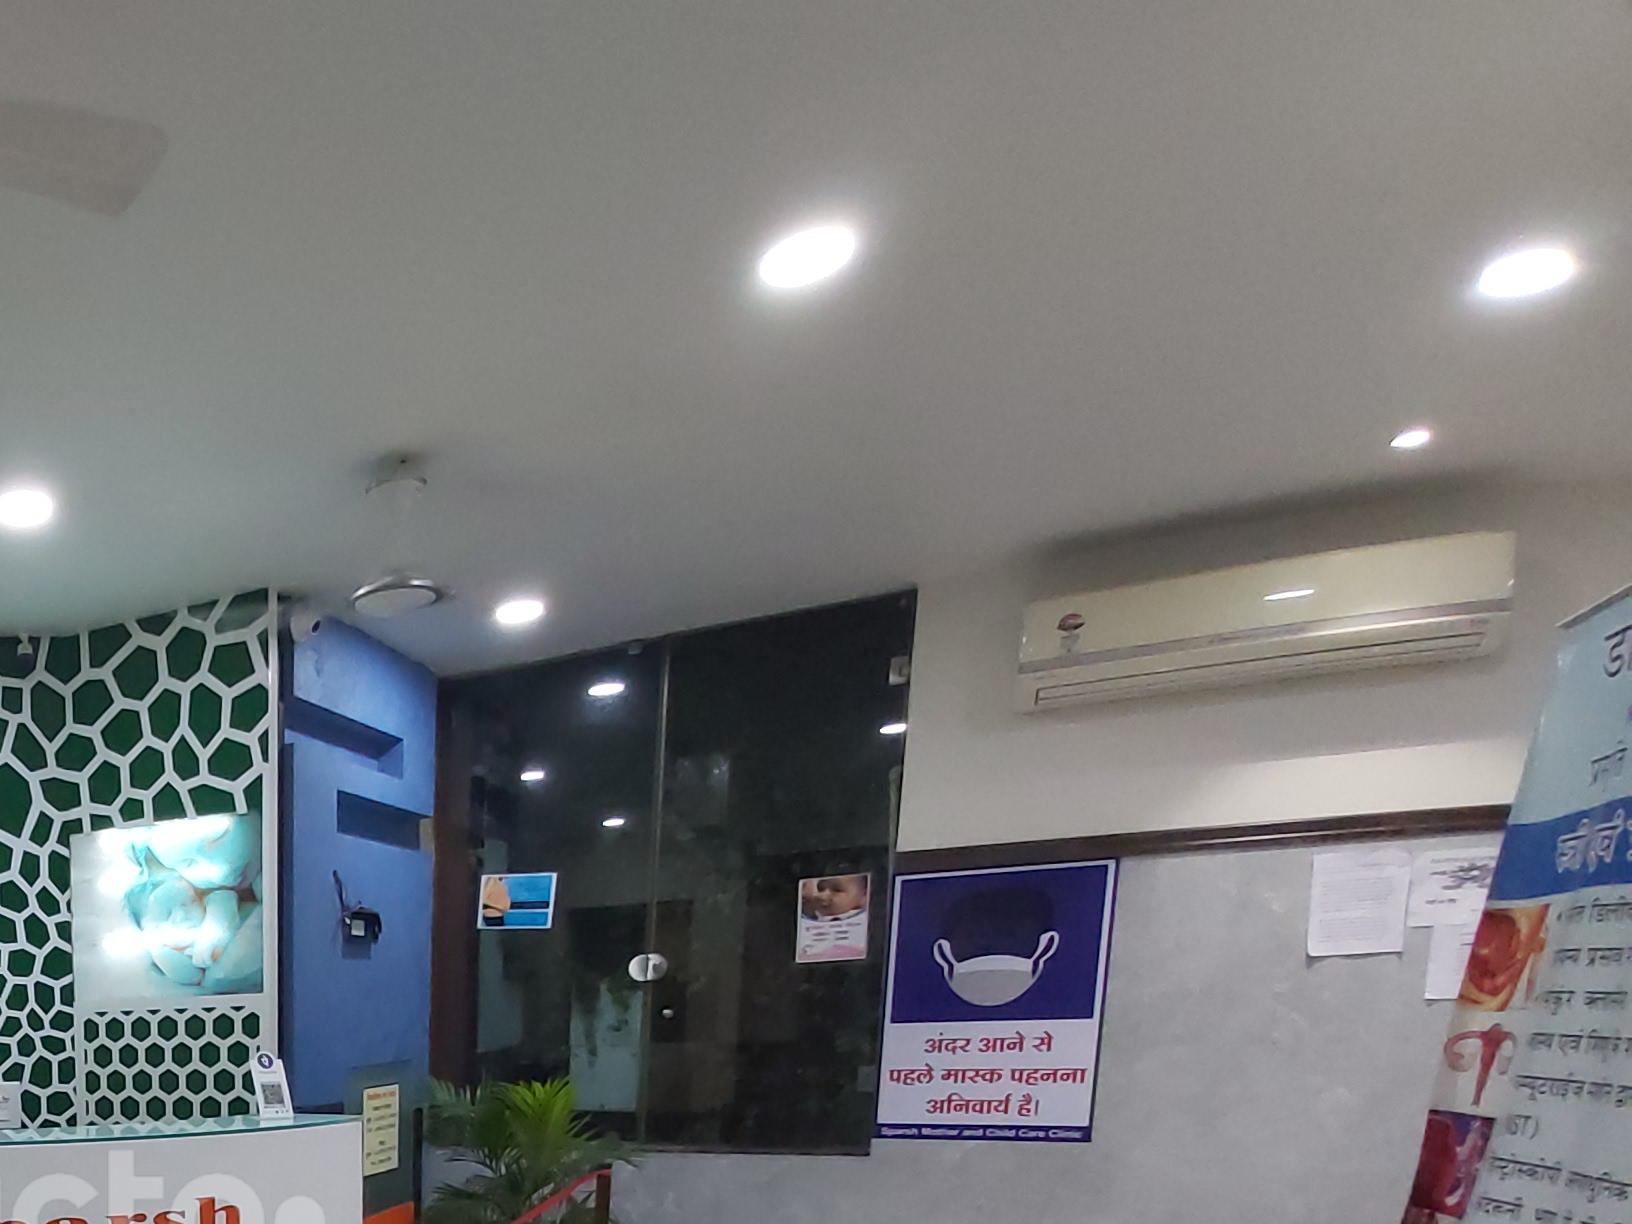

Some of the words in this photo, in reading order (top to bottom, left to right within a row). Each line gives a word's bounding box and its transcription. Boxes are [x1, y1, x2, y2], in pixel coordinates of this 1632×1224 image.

[924, 1032, 971, 1056] अंदर
[978, 1031, 1025, 1053] आने
[1033, 1030, 1054, 1053] से
[889, 1063, 935, 1086] पहले
[941, 1066, 1004, 1085] मास्क
[1010, 1066, 1088, 1086] पहनना
[926, 1092, 1013, 1115] अनिवार्य
